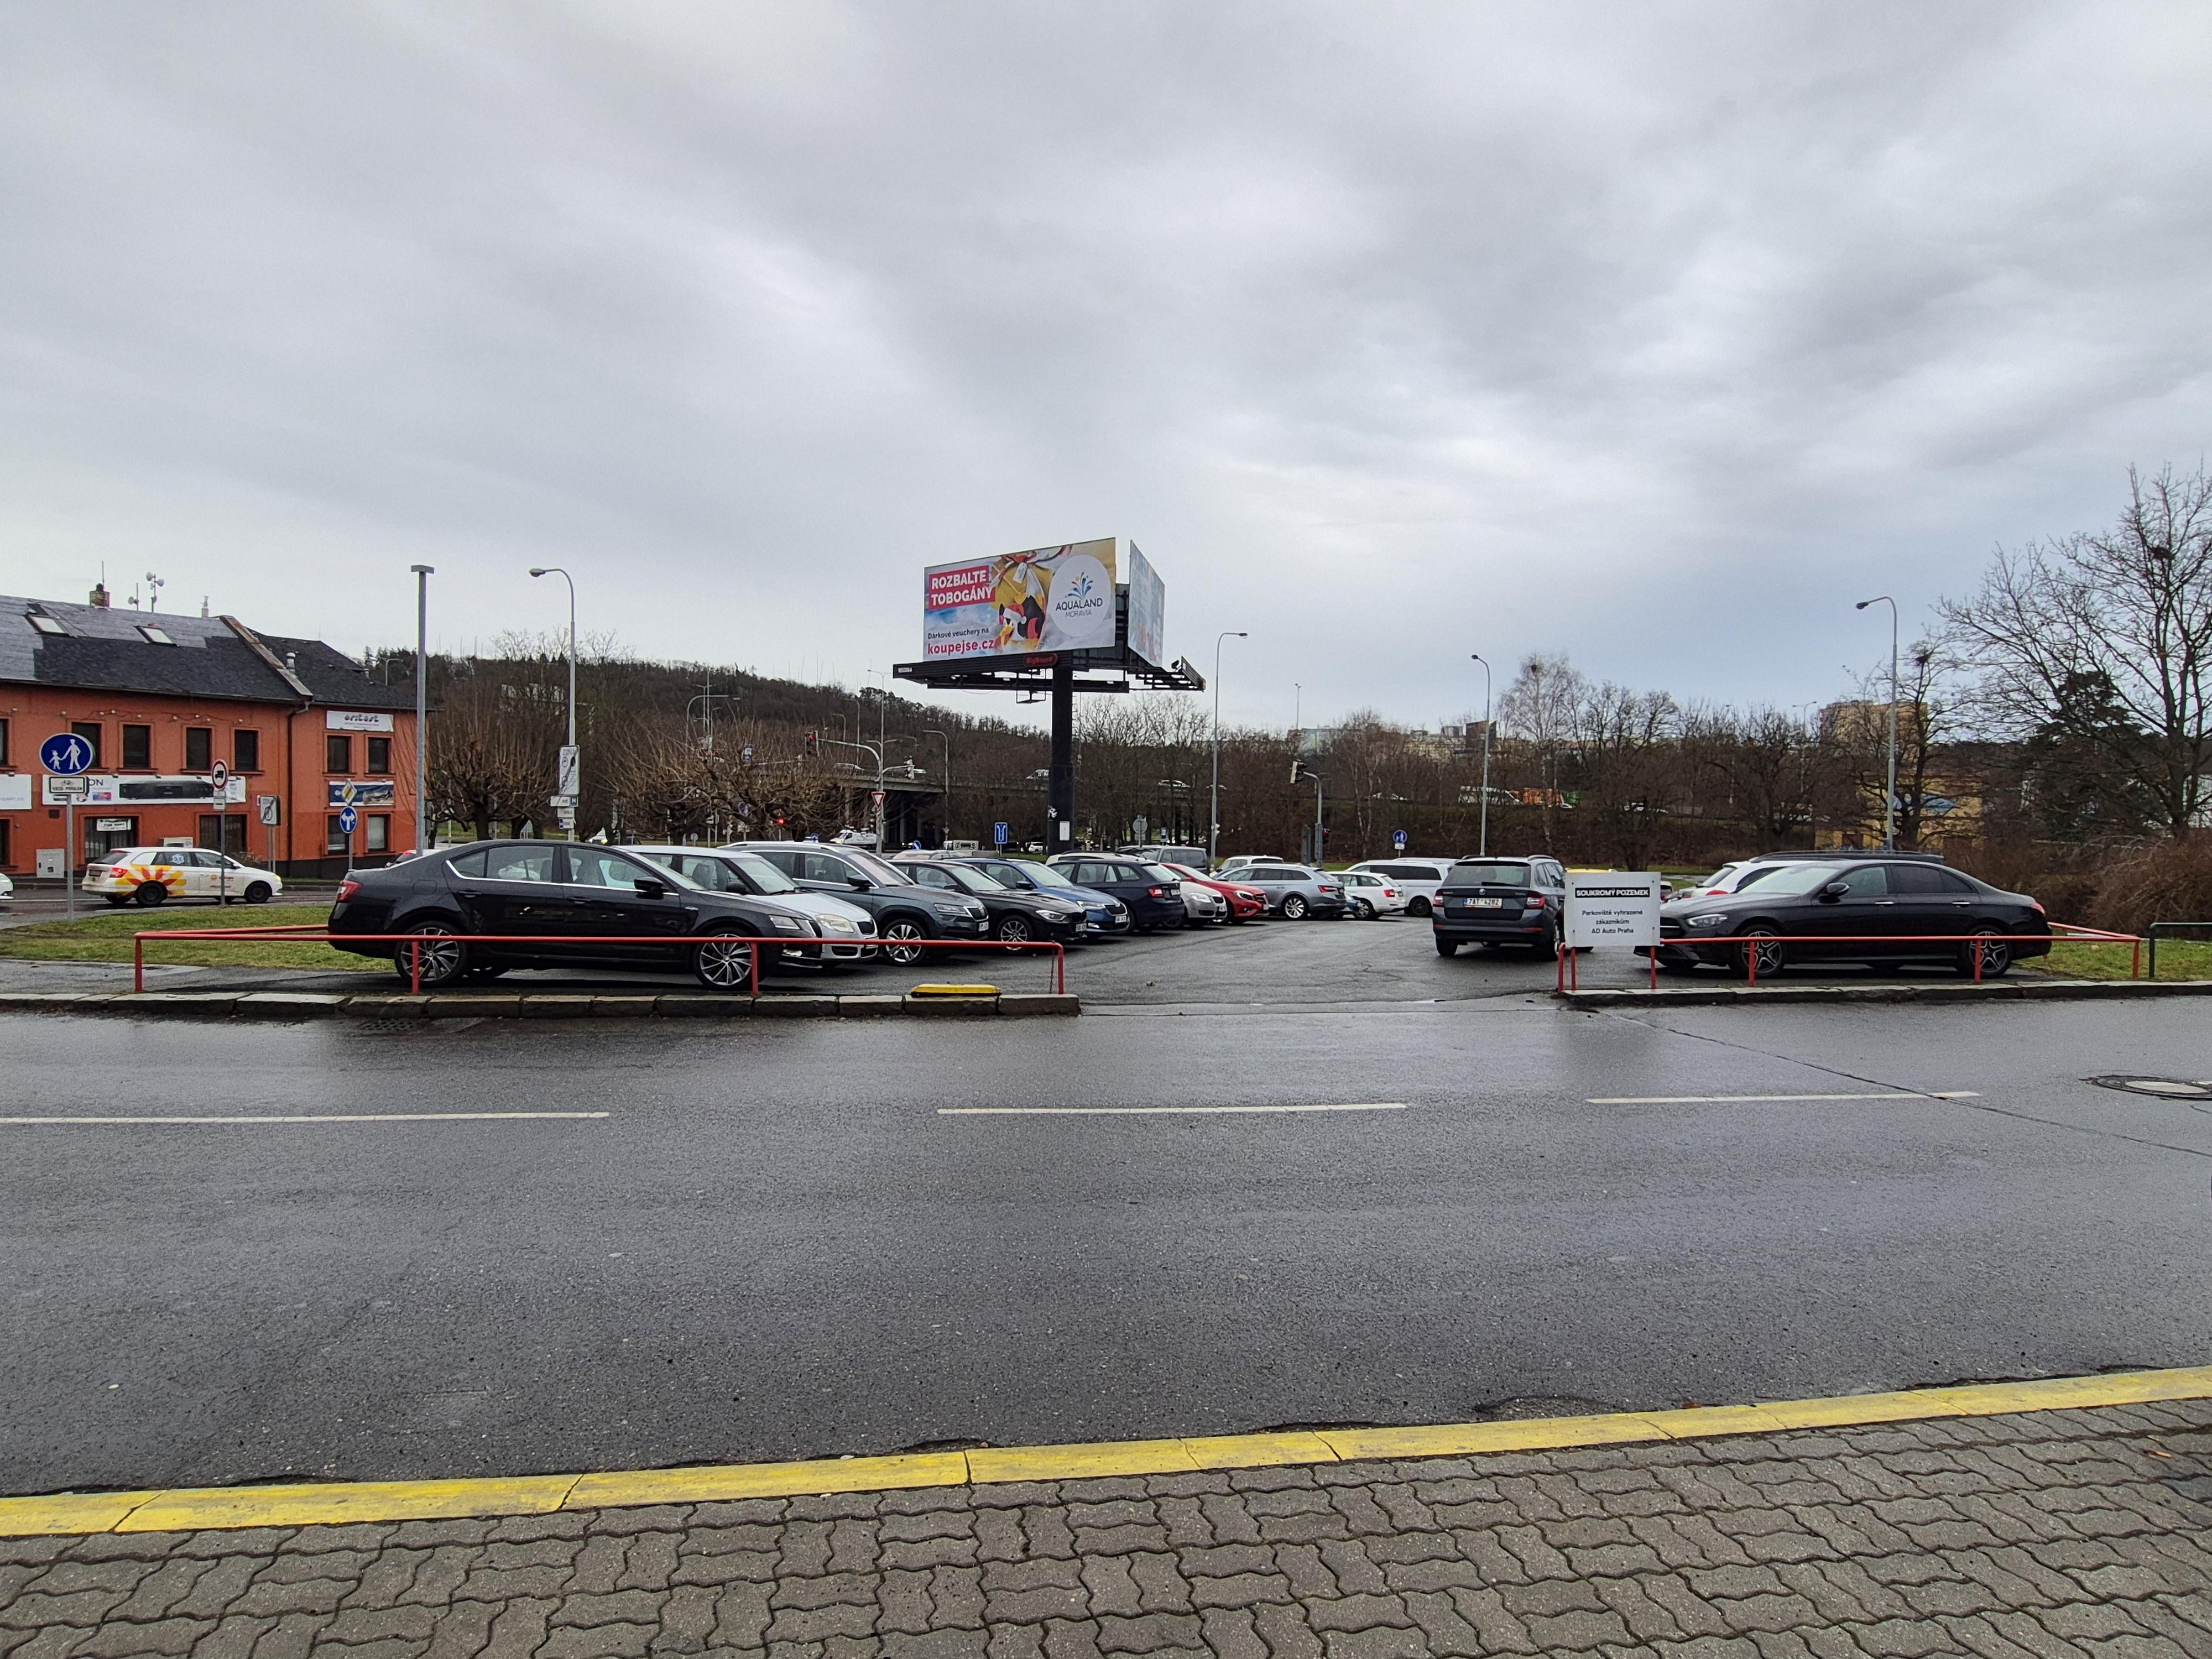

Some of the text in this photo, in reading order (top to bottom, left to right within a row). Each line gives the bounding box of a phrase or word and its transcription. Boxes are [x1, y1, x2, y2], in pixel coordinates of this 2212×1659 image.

[932, 570, 987, 589] ROZBALTE
[931, 585, 992, 606] TOBOGÁNY
[1056, 598, 1103, 611] AQUALAND
[1065, 609, 1092, 618] MORAVIA
[952, 628, 980, 637] vouchery
[928, 640, 994, 656] koupejse.cz
